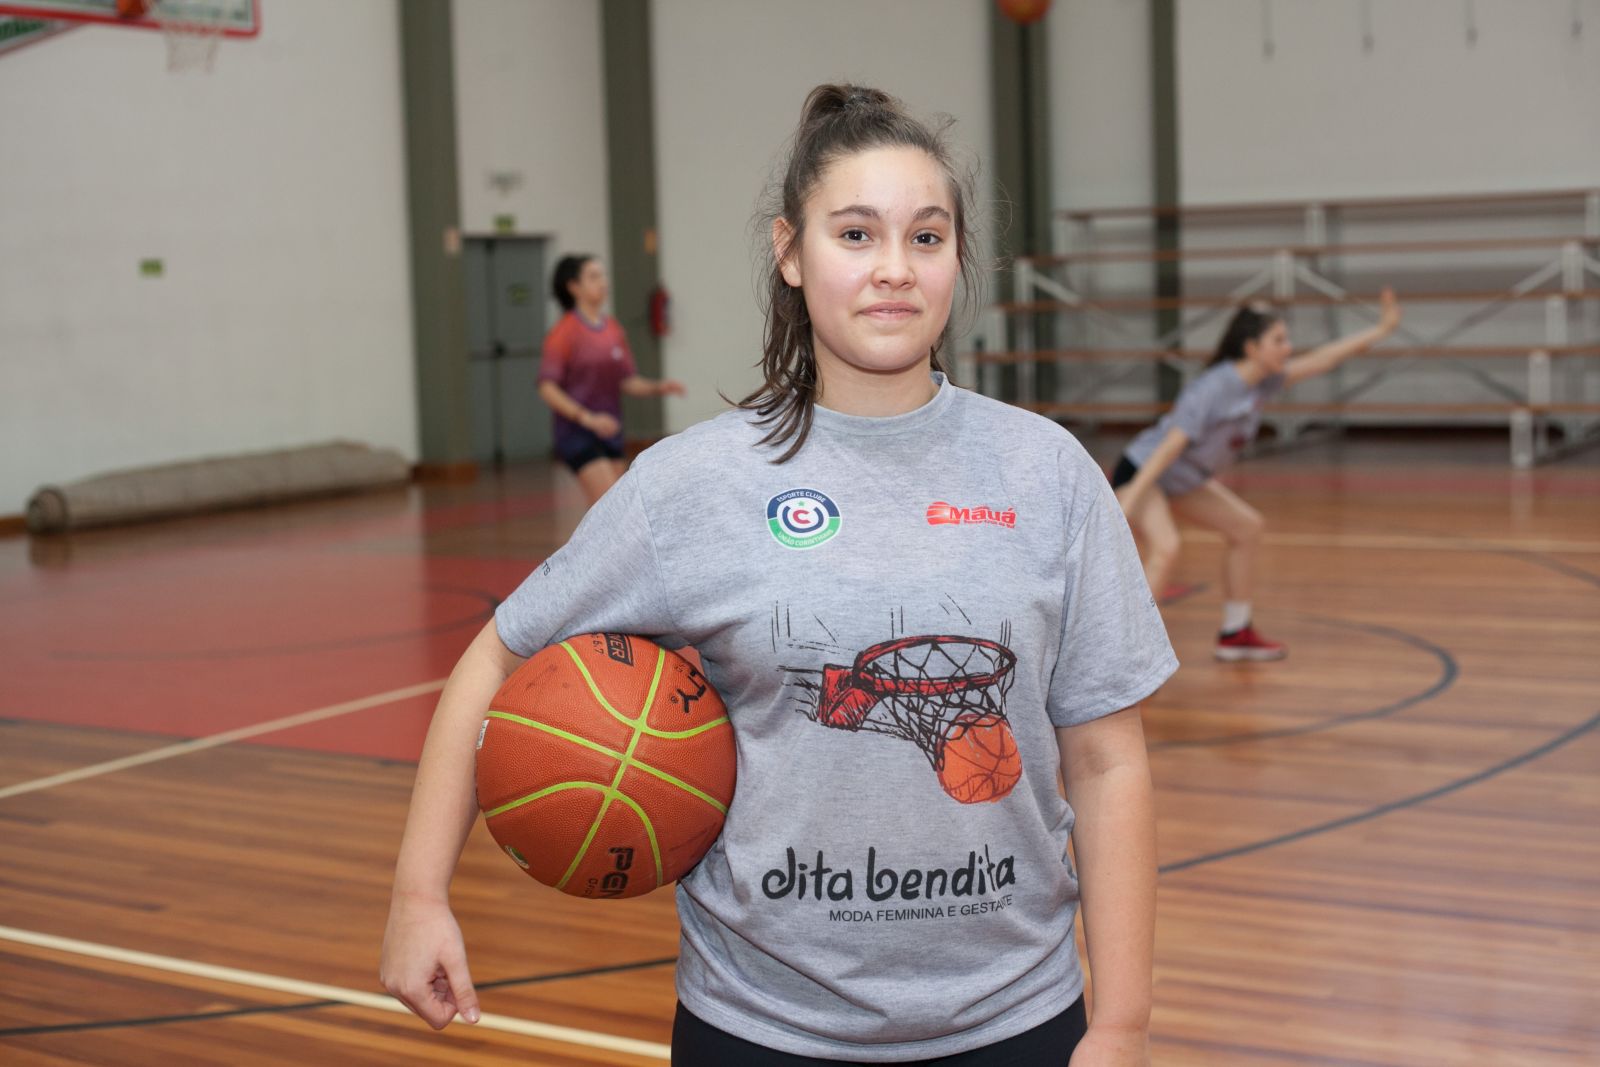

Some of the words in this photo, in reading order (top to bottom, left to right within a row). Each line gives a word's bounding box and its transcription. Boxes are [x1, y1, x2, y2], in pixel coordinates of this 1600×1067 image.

[805, 491, 826, 503] CLUBE
[949, 505, 1016, 525] Mauá
[761, 846, 853, 901] dita
[865, 844, 1016, 902] bendita
[829, 910, 873, 921] MODA
[876, 907, 944, 921] FEMININA
[947, 905, 956, 917] E
